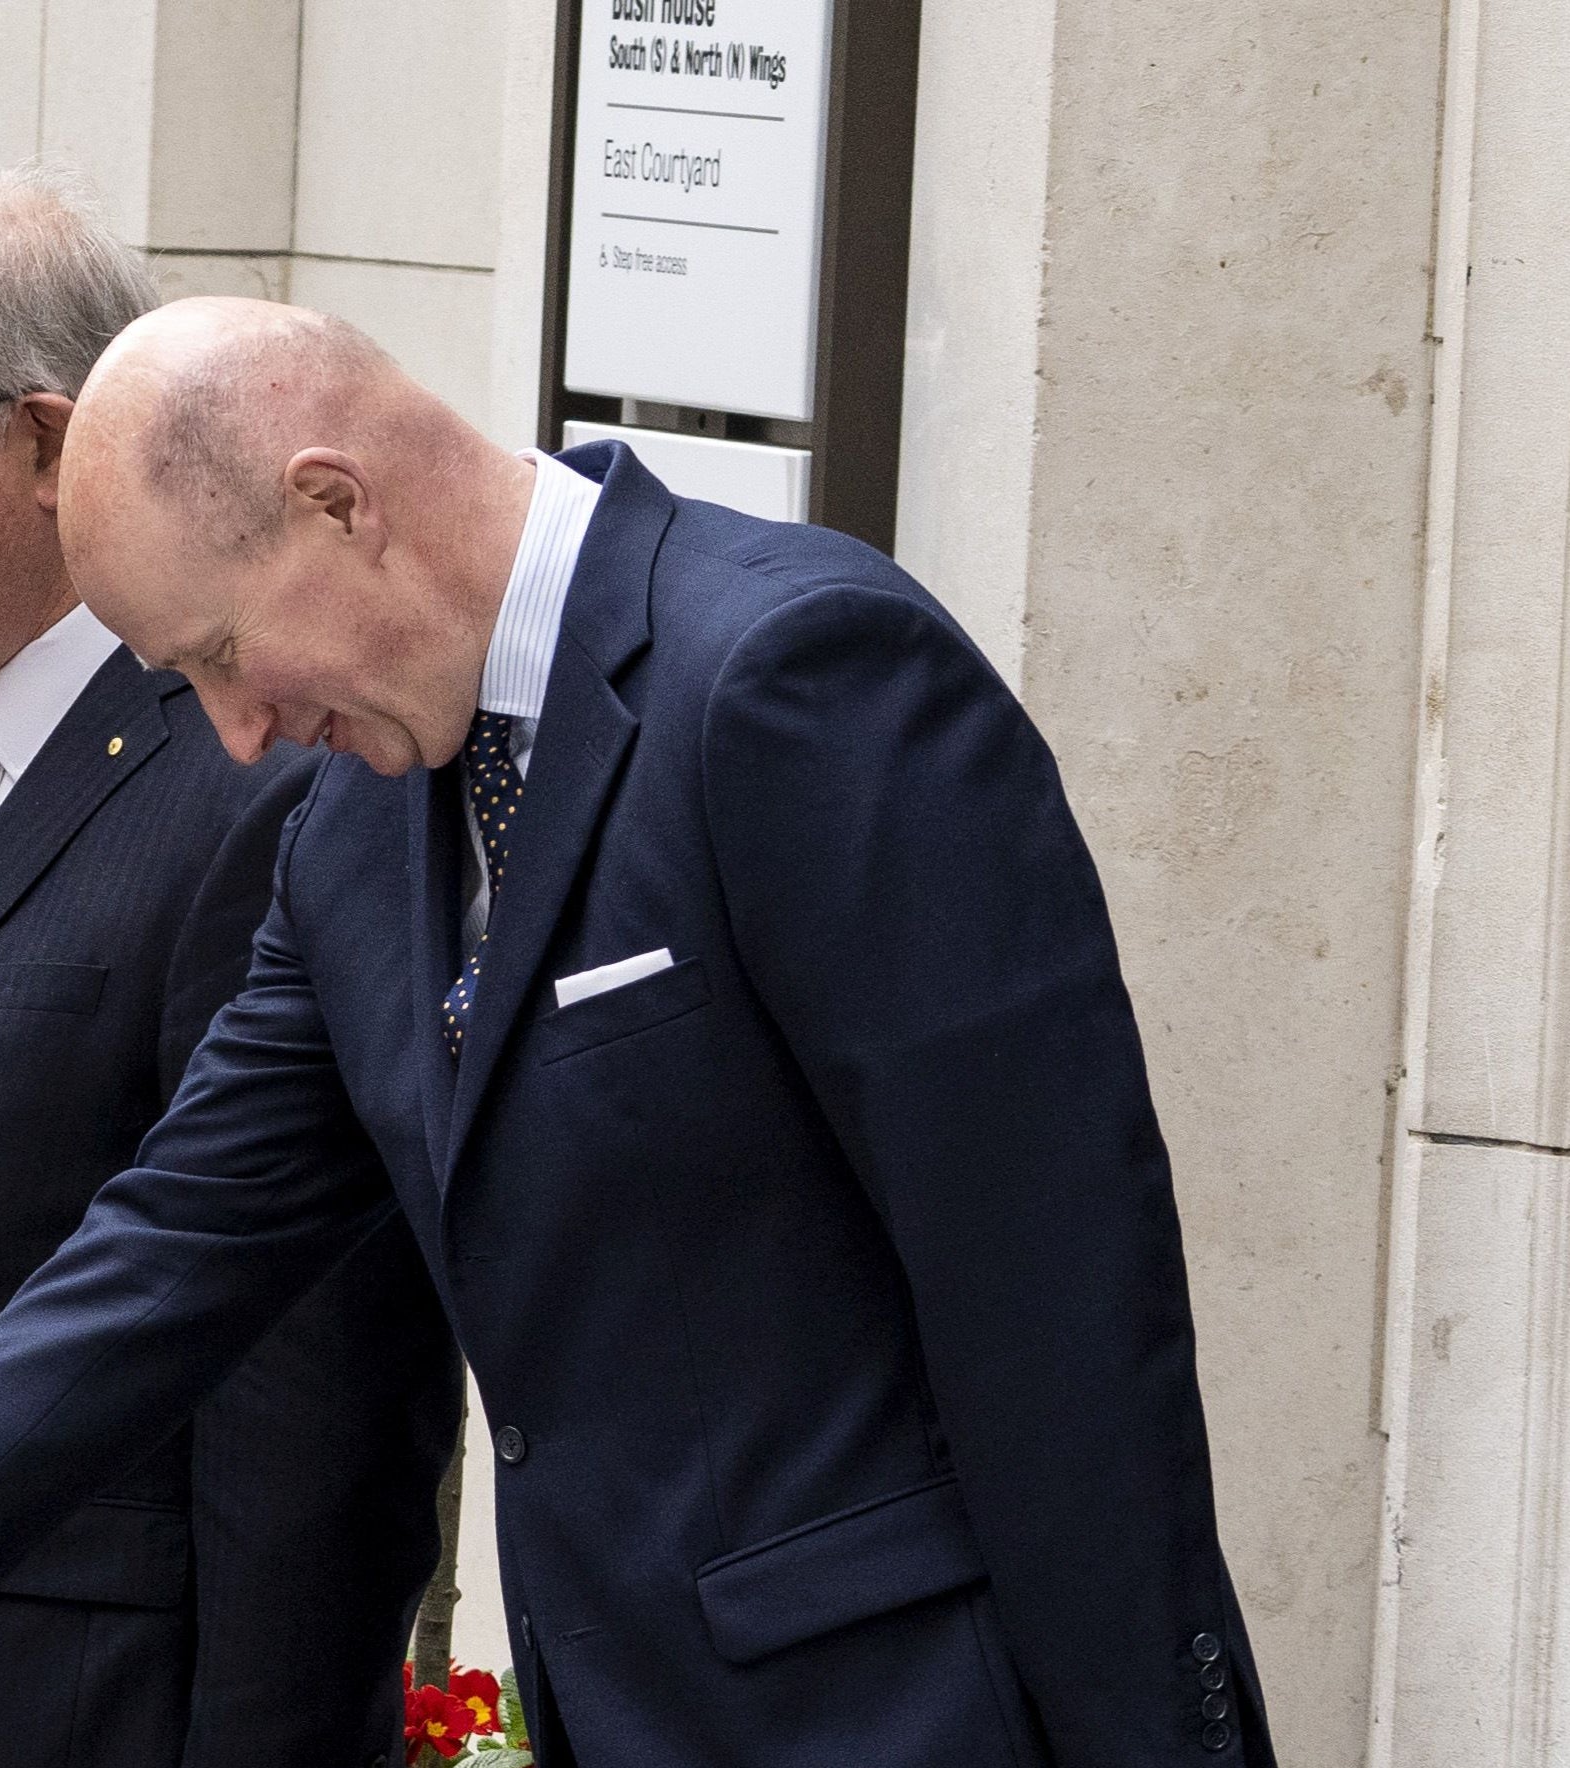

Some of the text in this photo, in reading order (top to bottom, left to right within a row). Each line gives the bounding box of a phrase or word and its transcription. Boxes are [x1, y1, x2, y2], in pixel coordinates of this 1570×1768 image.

[609, 35, 787, 90] South (S) & North (N) Wings
[604, 139, 723, 193] East Courtyard
[613, 245, 687, 276] Step free access
